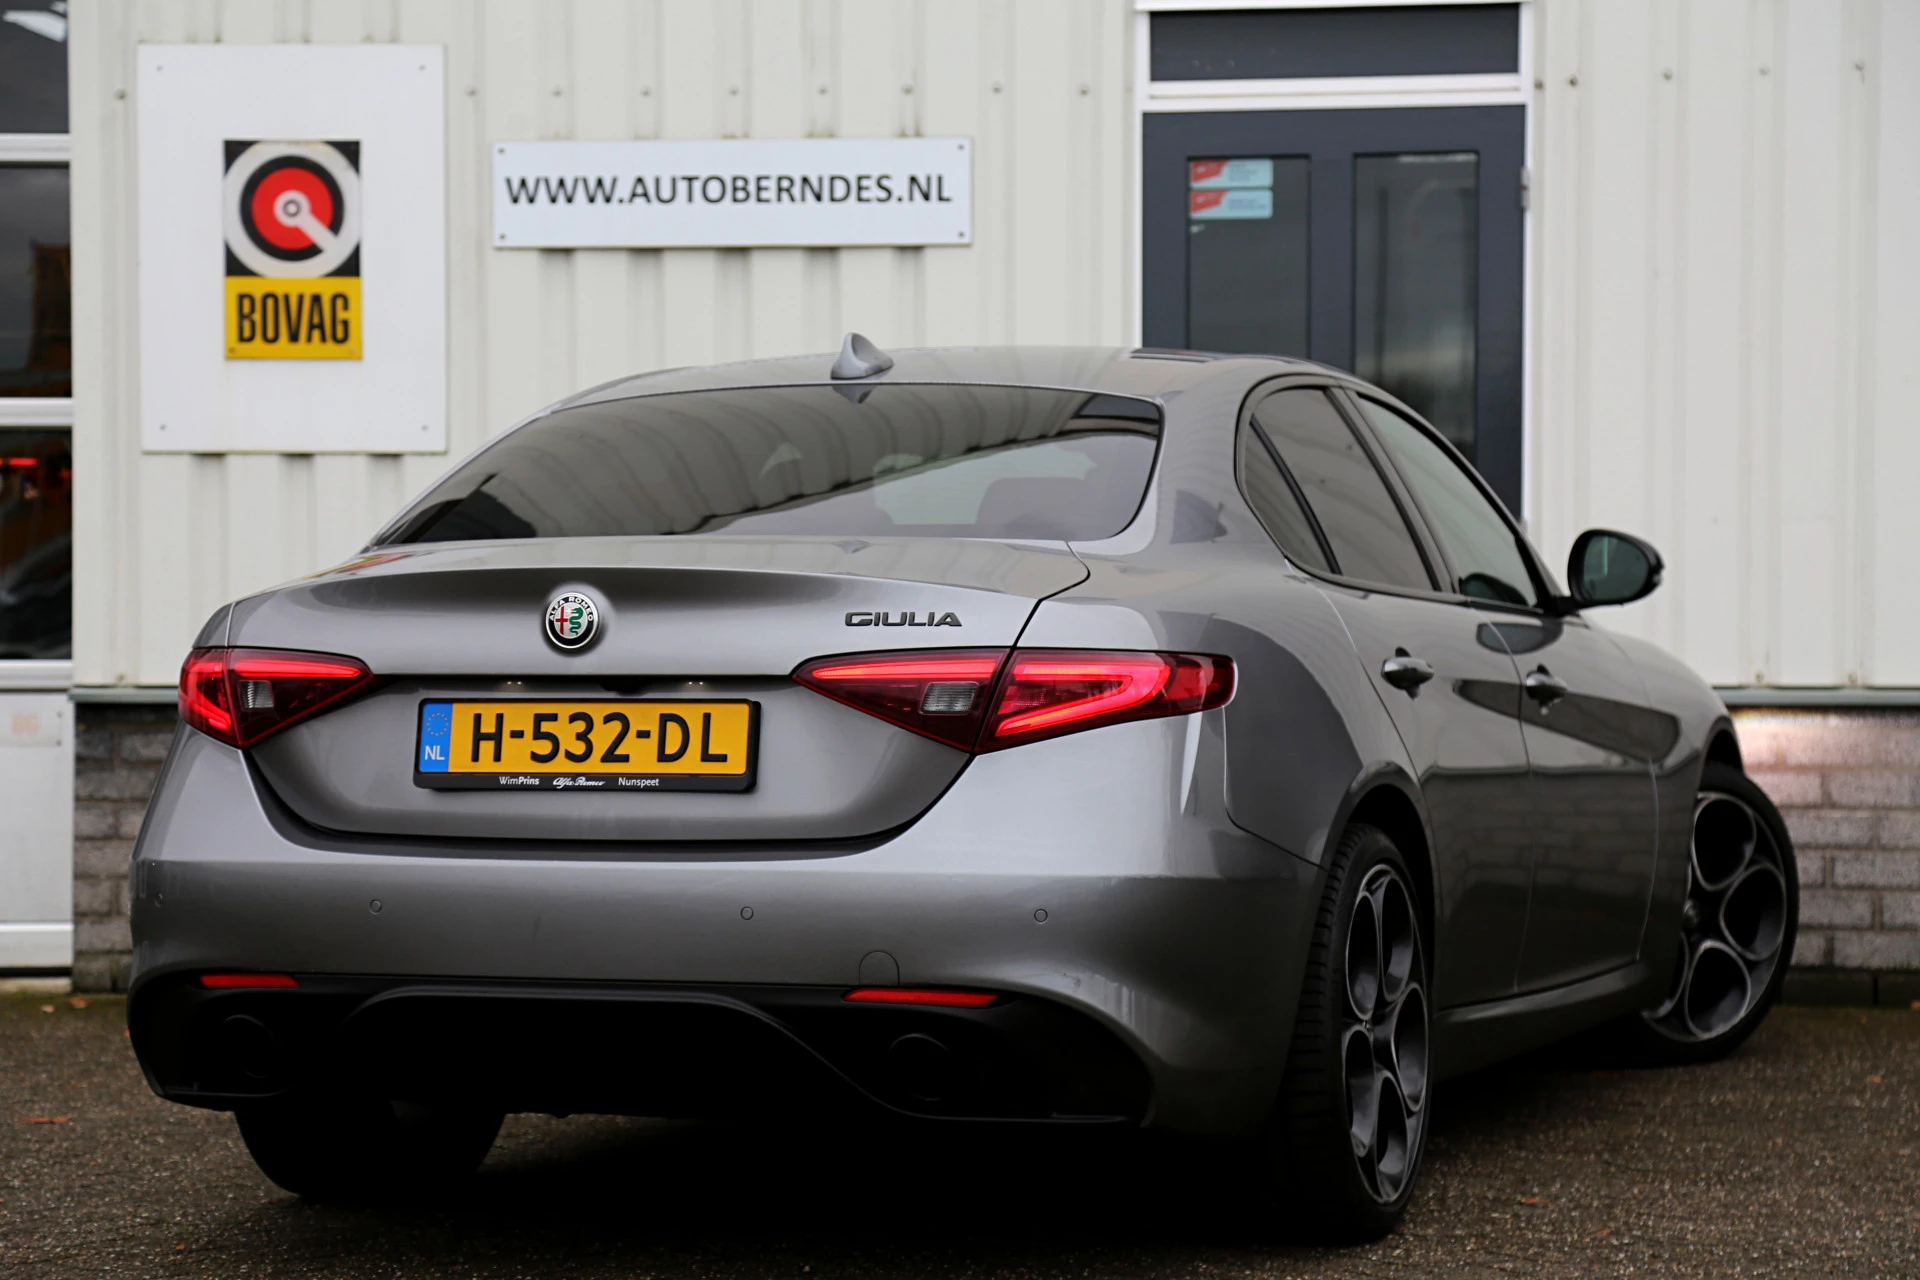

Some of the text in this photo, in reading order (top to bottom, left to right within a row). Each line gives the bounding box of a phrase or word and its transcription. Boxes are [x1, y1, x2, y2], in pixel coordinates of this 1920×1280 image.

[505, 174, 953, 205] WWW.AUTOBERNDES.NL
[236, 292, 350, 345] BOVAG
[549, 596, 594, 621] ALFA ROMEO
[844, 611, 963, 627] GIULIA
[470, 711, 729, 764] H-532-DL
[424, 745, 446, 761] NL
[618, 776, 660, 789] Nunspeet
